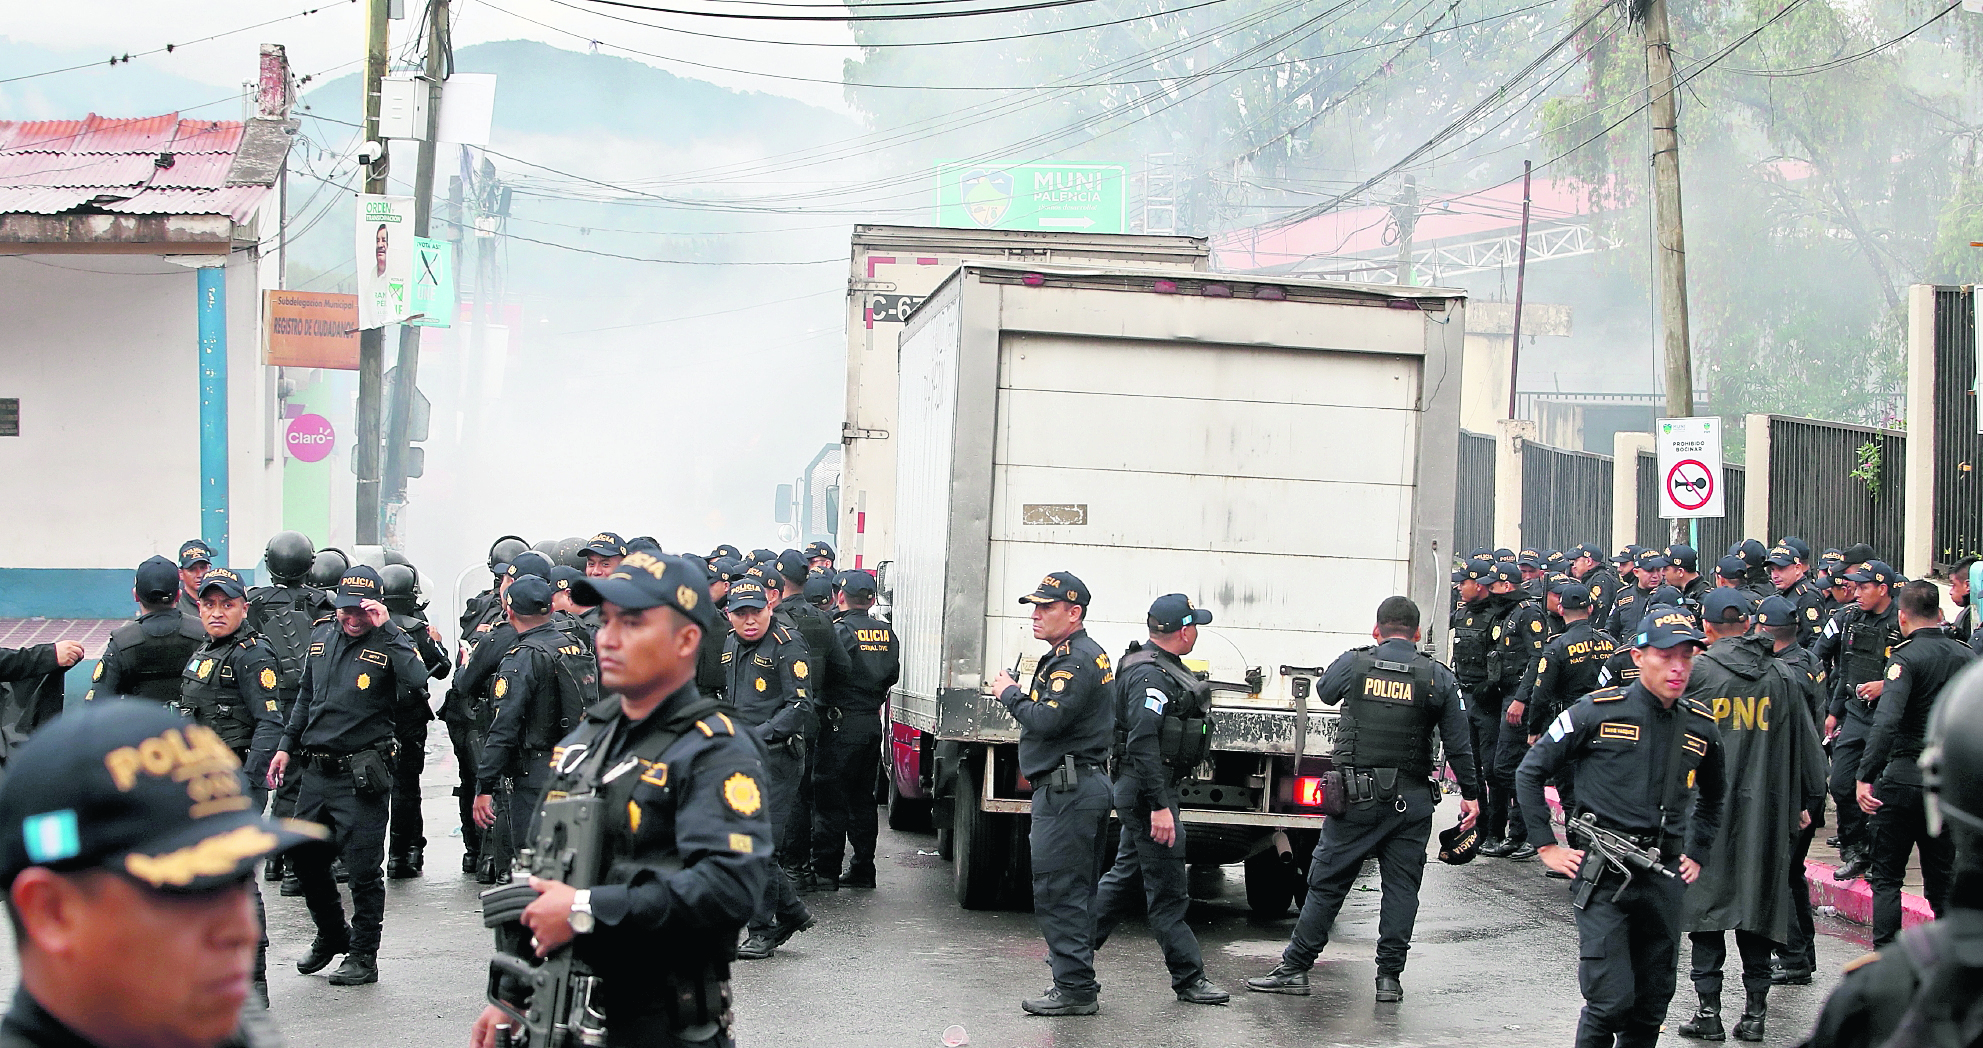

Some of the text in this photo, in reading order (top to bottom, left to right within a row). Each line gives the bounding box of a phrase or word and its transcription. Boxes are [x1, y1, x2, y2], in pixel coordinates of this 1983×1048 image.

[1034, 172, 1102, 190] MUNI
[1034, 192, 1101, 201] PALENCIA
[366, 202, 392, 213] ORDEN
[324, 299, 354, 310] Municipal
[273, 317, 302, 335] REGISTRO
[304, 319, 312, 336] DE
[289, 430, 329, 444] Claro
[203, 568, 238, 582] POLICIA
[341, 576, 375, 589] POLICIA
[730, 583, 762, 596] POLICIA
[855, 629, 890, 643] OLICIA
[1364, 677, 1412, 701] POLICIA
[1711, 696, 1771, 731] PNC
[1452, 830, 1478, 855] POLICIA
